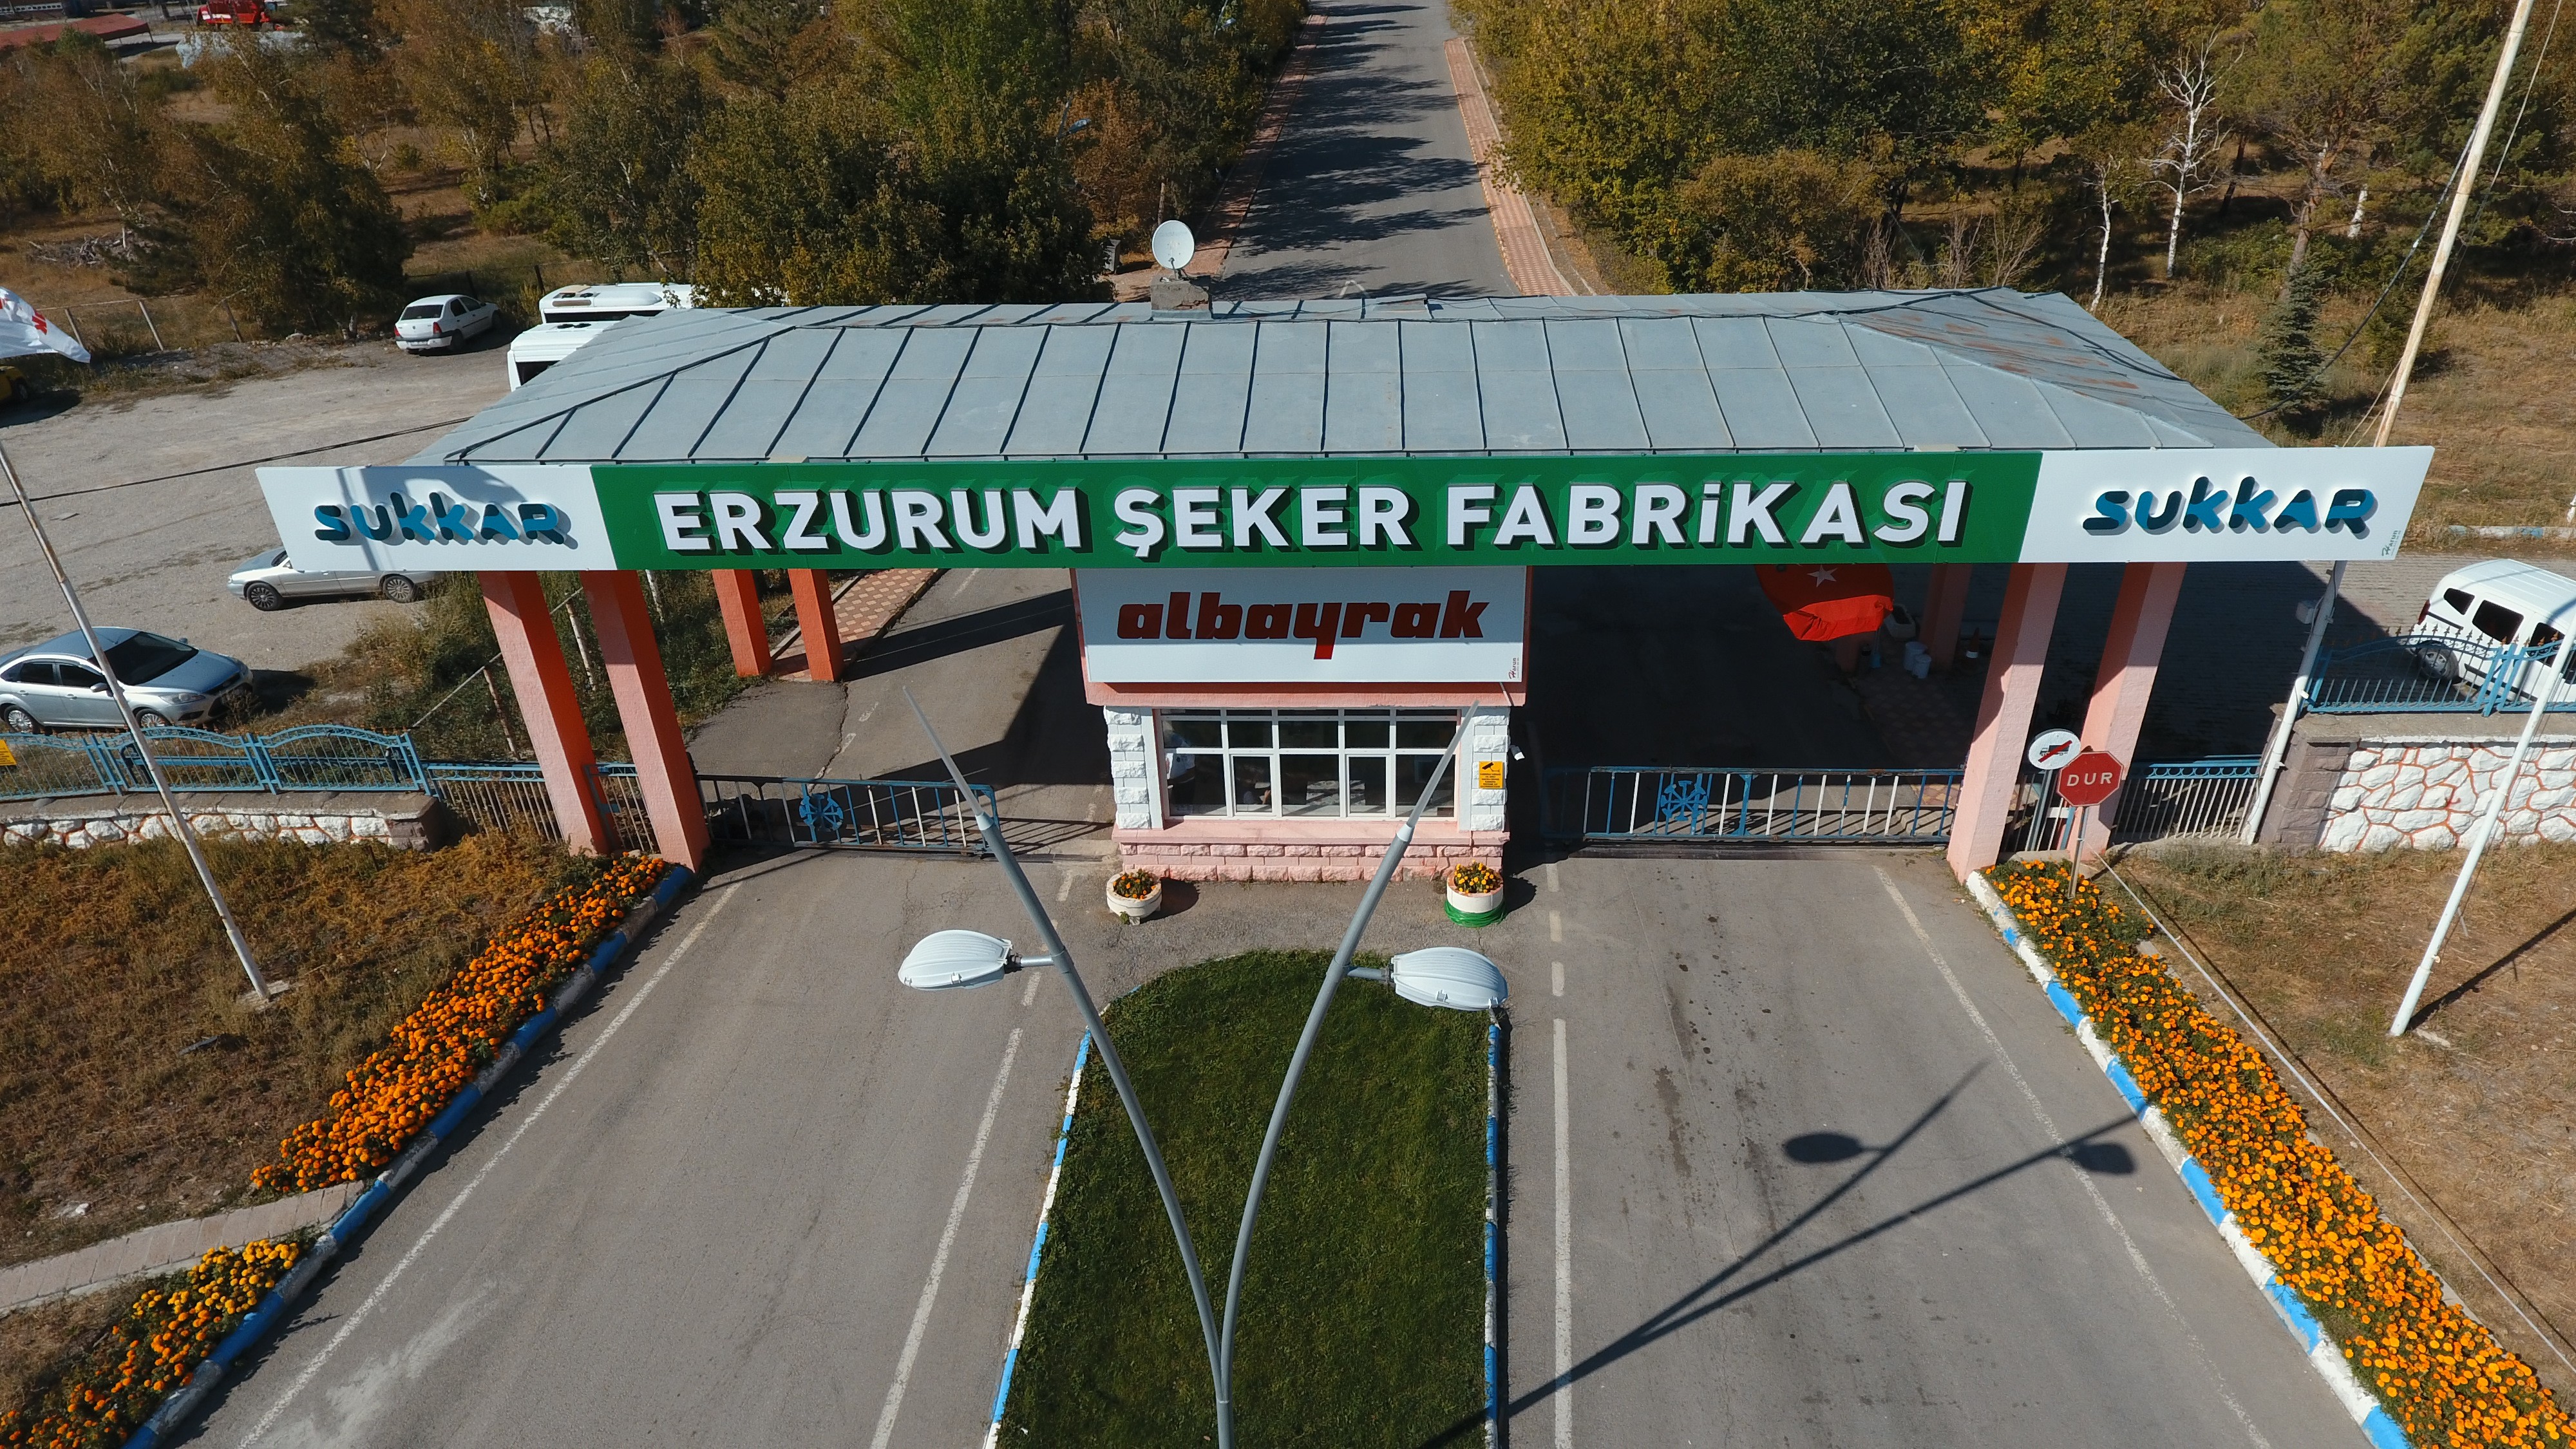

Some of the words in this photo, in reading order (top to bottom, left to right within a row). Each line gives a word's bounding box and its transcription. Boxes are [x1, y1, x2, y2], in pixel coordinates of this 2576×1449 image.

[652, 489, 1082, 551] ERZURUM
[1113, 485, 1412, 558] ŞEKER
[1117, 591, 1488, 660] albayrak
[2067, 772, 2113, 786] DUR
